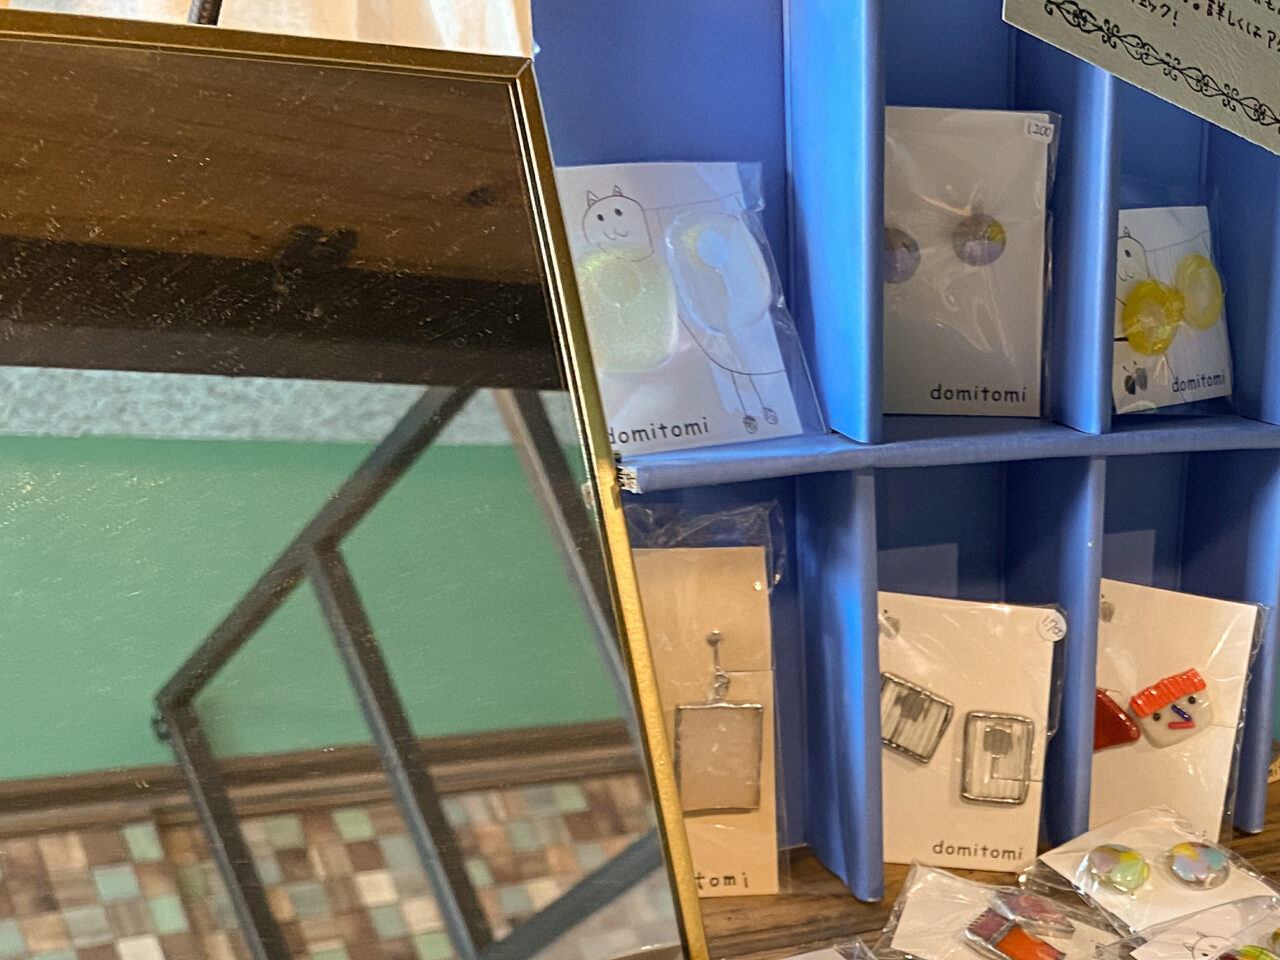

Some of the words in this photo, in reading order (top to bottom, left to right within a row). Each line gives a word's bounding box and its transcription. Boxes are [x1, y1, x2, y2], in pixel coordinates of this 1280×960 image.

[1171, 370, 1225, 392] domitomi
[930, 384, 1027, 402] domitomi
[932, 840, 1023, 861] domitomi
